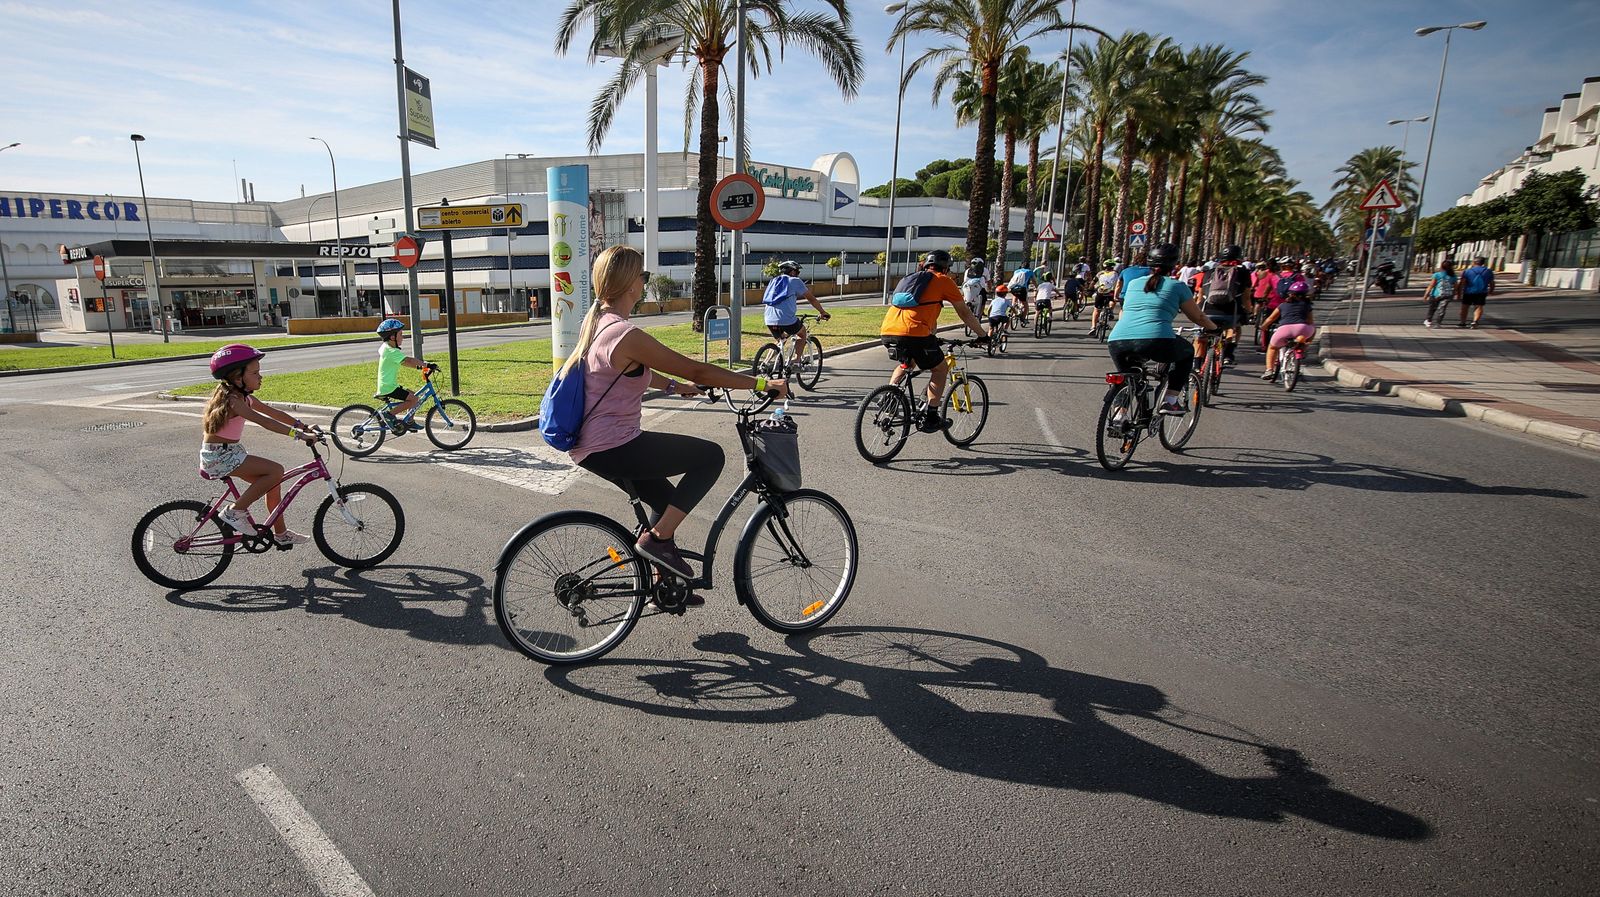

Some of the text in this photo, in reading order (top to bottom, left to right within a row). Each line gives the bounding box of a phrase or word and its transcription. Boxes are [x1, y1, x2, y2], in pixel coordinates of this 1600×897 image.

[759, 167, 783, 189] Corte
[782, 167, 814, 199] Inglés
[0, 197, 140, 221] HIPERCOR
[735, 196, 745, 204] 12
[578, 214, 587, 257] Welcome
[319, 246, 369, 257] REPSO
[108, 278, 146, 286] SUPERCO
[579, 269, 588, 323] ienvenidos
